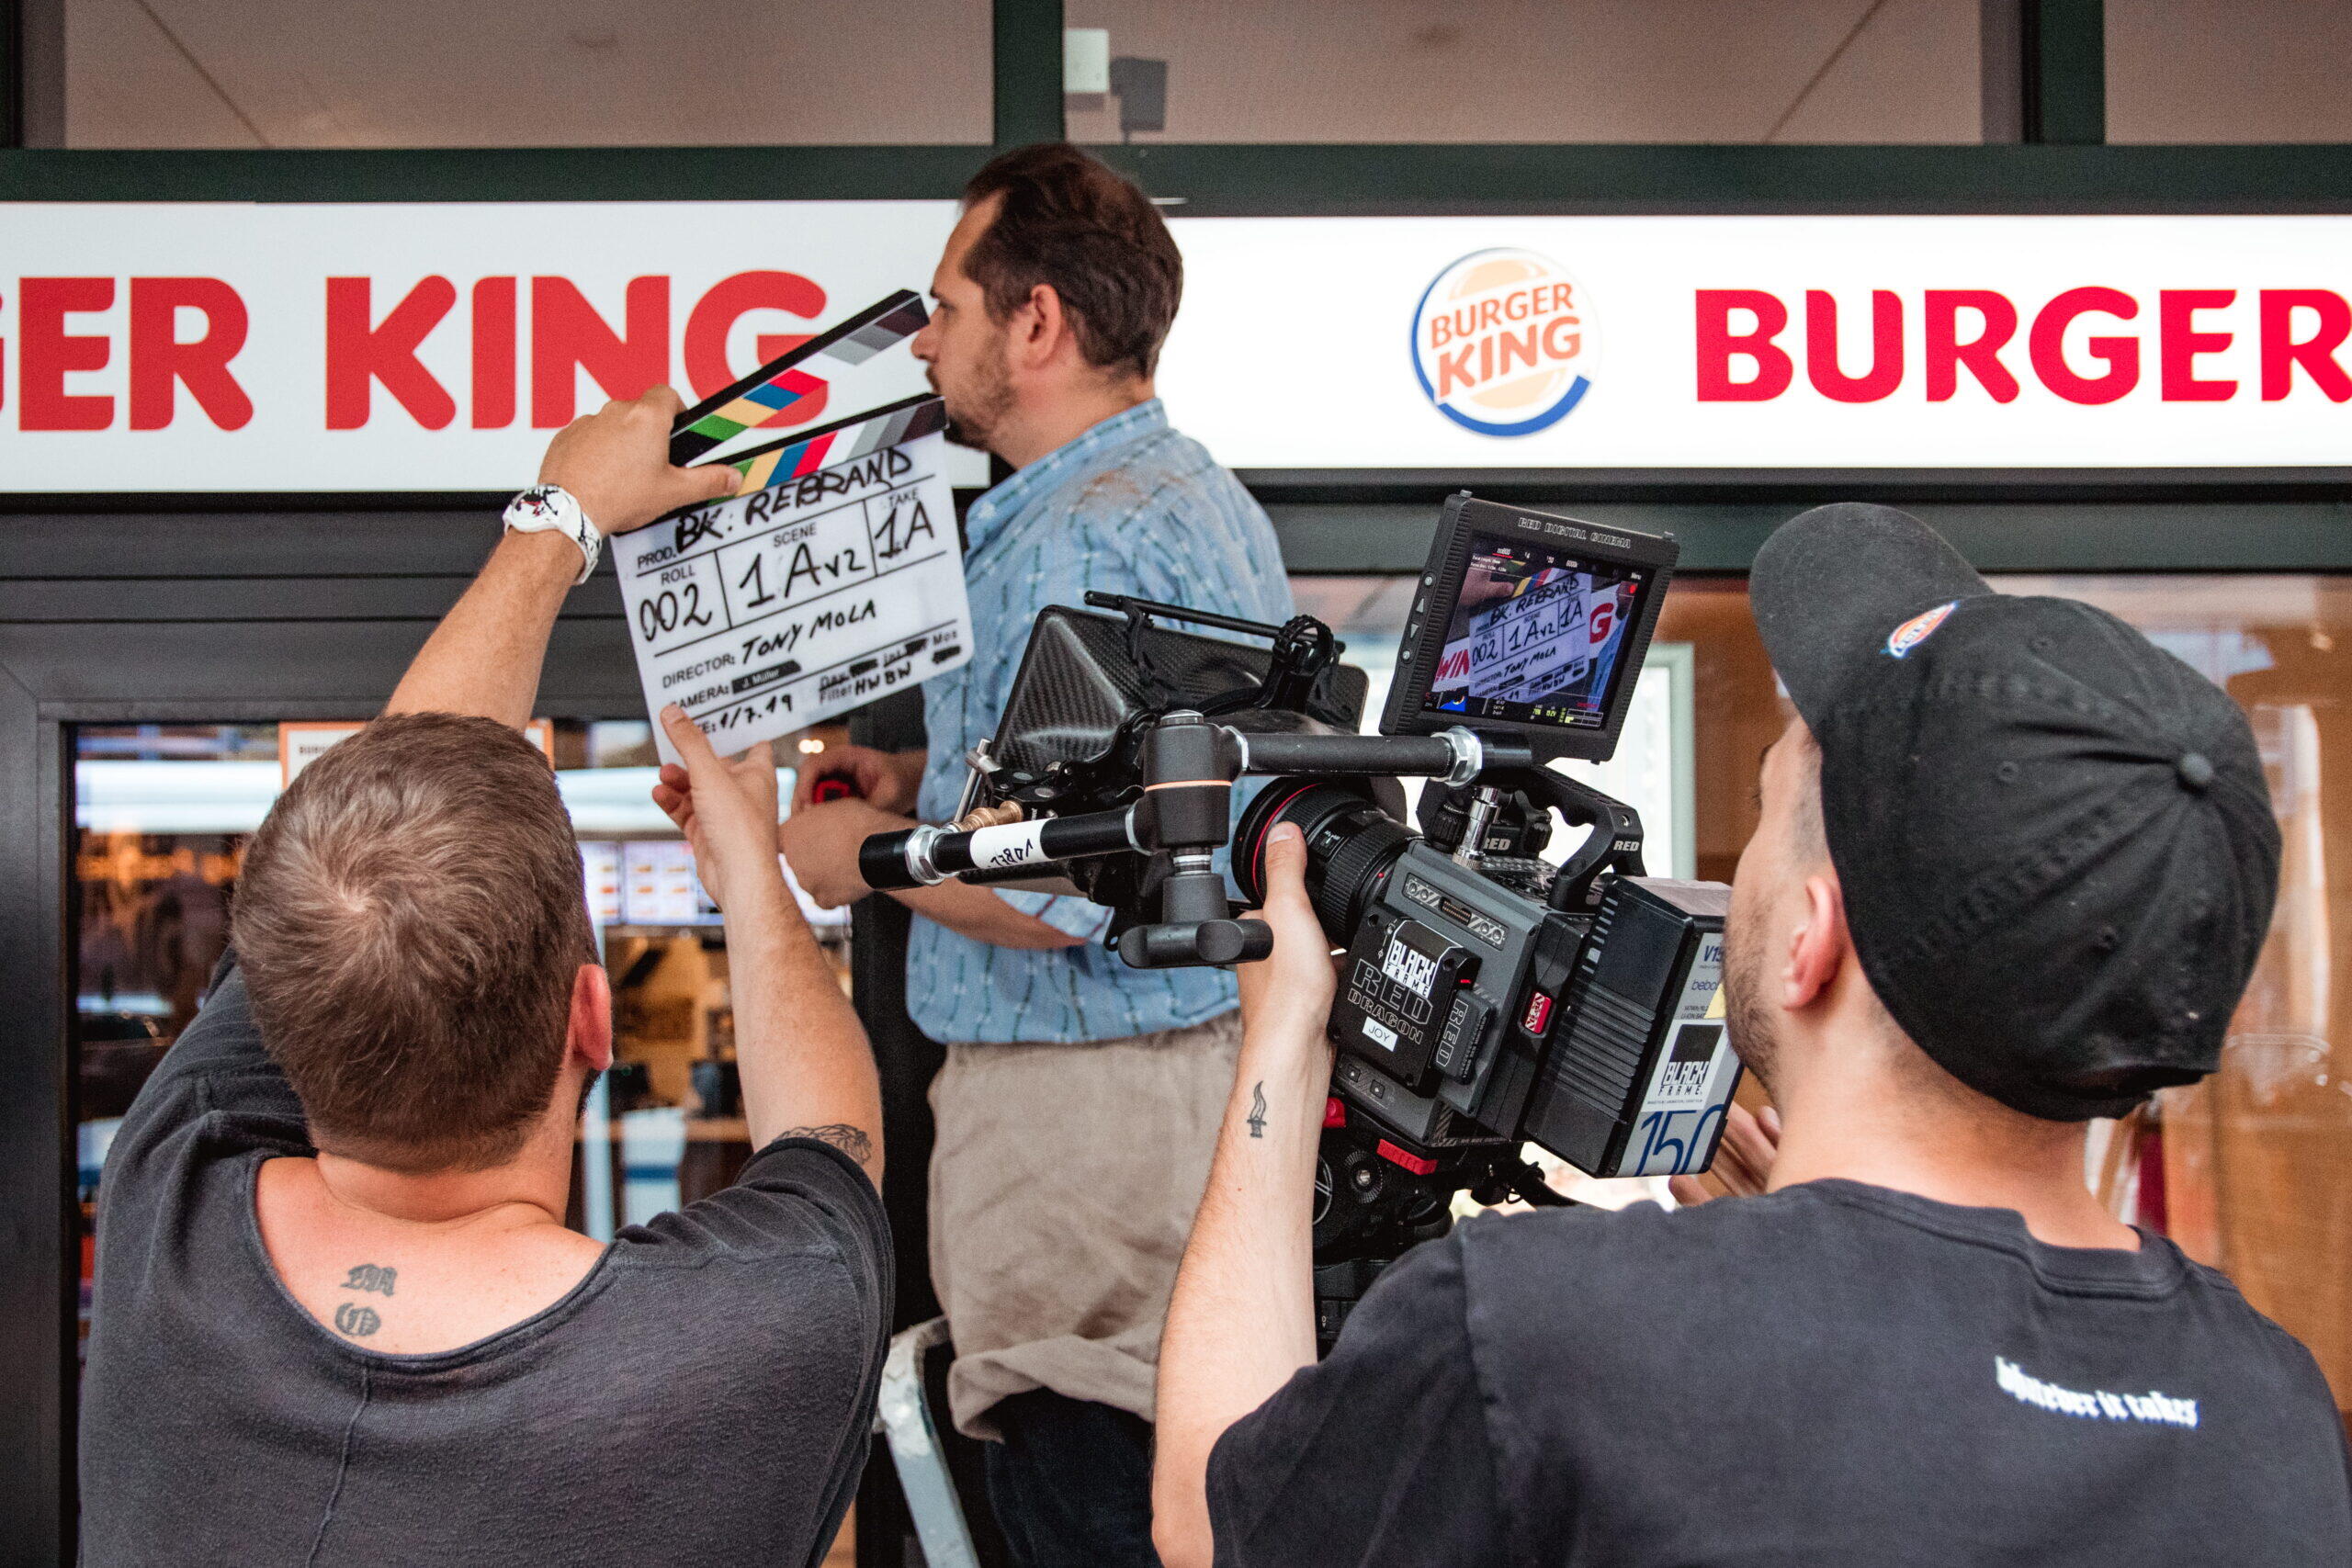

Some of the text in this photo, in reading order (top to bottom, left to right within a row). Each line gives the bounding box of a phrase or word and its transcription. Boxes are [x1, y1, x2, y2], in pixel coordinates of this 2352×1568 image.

[1431, 283, 1574, 350] BURGER
[0, 276, 254, 432] ER
[1439, 316, 1581, 398] KING
[1694, 286, 2352, 405] BURGER
[744, 447, 912, 525] REBRAND
[889, 490, 919, 506] TAKE
[774, 523, 817, 548] SCENE
[1518, 517, 1541, 531] RED
[661, 565, 696, 585] ROLL
[741, 599, 876, 665] TONY MOLA
[662, 653, 735, 689] DIRECTOR:
[672, 683, 729, 709] AMERA:
[1613, 840, 1640, 852] RED
[1385, 964, 1430, 997] FRAME
[1389, 939, 1437, 987] BLACK
[1352, 958, 1433, 1025] RED
[1347, 987, 1424, 1045] DRAGON
[1368, 1024, 1391, 1043] JOY
[1435, 998, 1468, 1067] RED
[1661, 1061, 1710, 1086] BLACK
